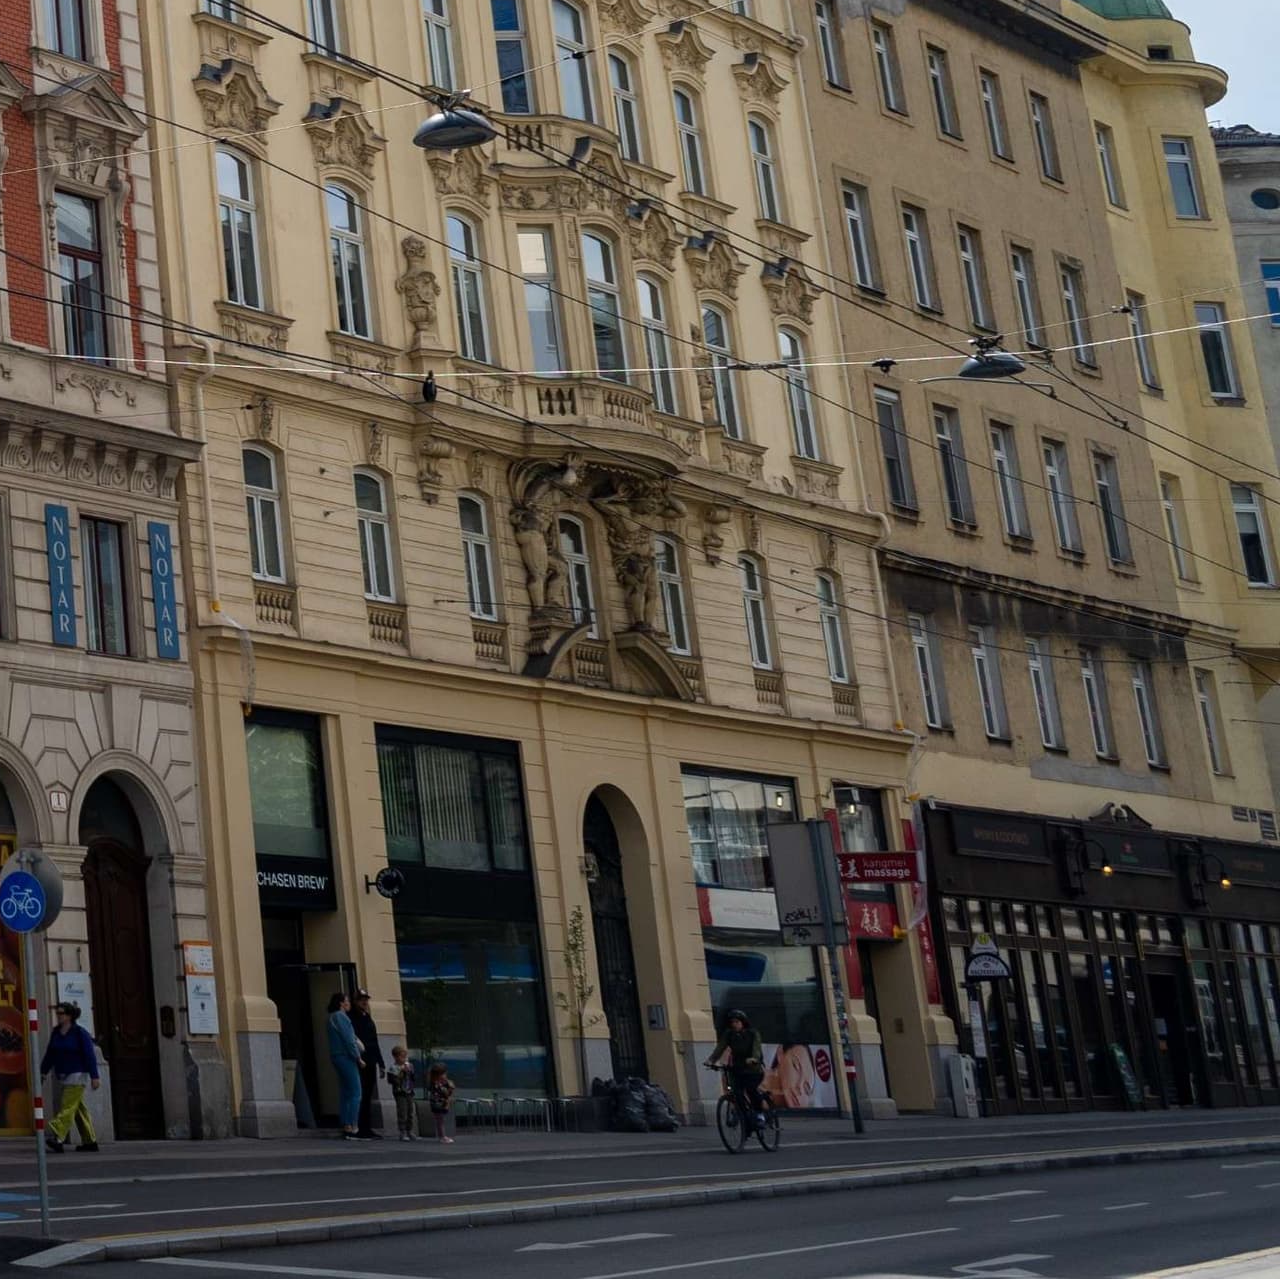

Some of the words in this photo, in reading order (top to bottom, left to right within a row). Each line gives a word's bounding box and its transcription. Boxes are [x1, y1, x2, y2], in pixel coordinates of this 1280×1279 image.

[52, 515, 71, 634] NOTAR
[154, 532, 174, 648] NOTAR
[256, 871, 298, 889] CHASEN
[864, 869, 911, 879] massage
